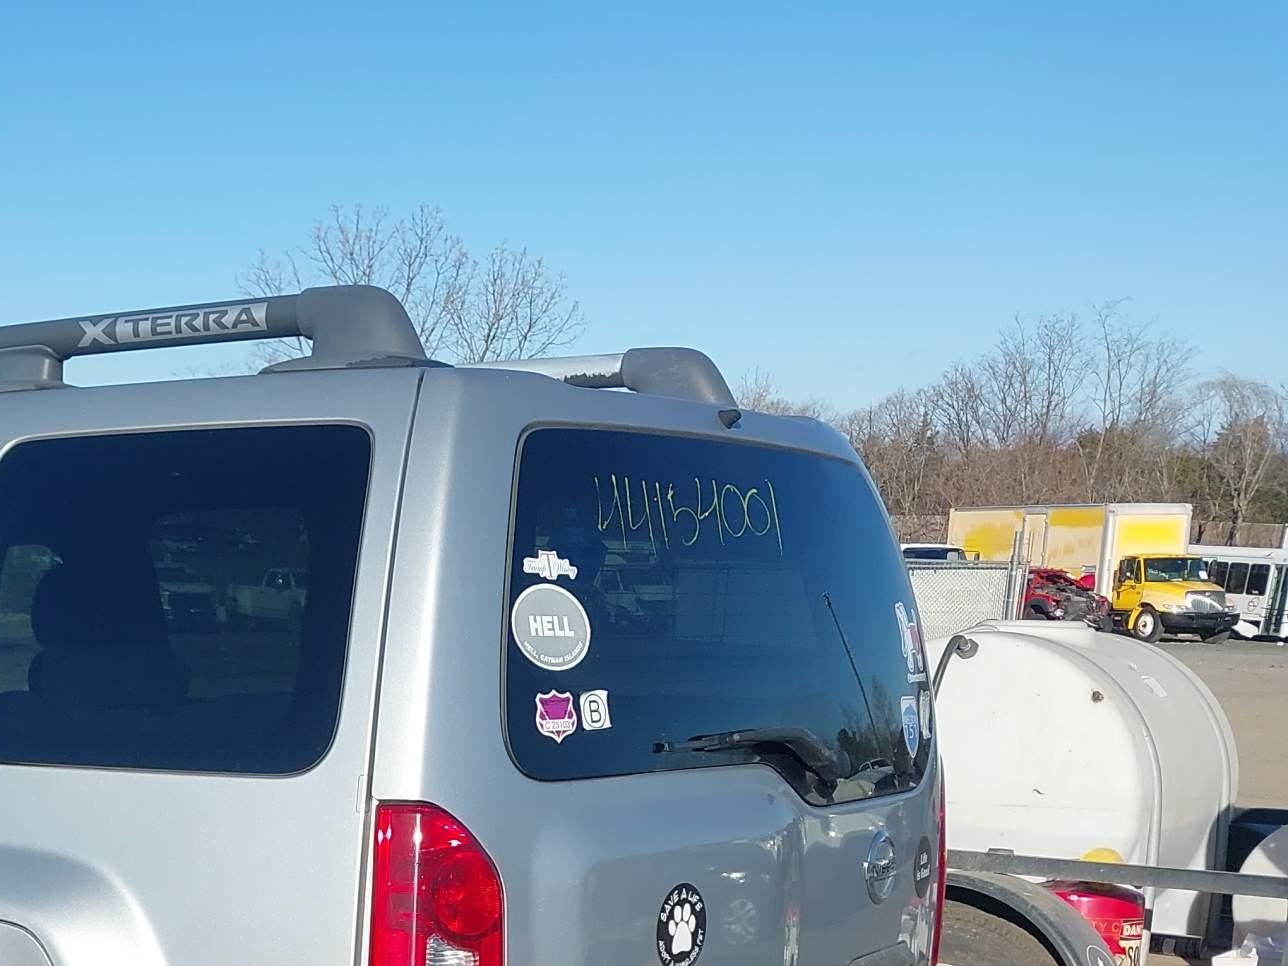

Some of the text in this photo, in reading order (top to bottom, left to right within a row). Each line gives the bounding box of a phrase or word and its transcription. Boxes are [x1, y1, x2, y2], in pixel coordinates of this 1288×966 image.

[77, 306, 261, 347] XTERRA
[594, 474, 783, 558] 44154001
[528, 615, 575, 637] HELL
[660, 890, 680, 922] SAVE
[680, 888, 688, 900] A
